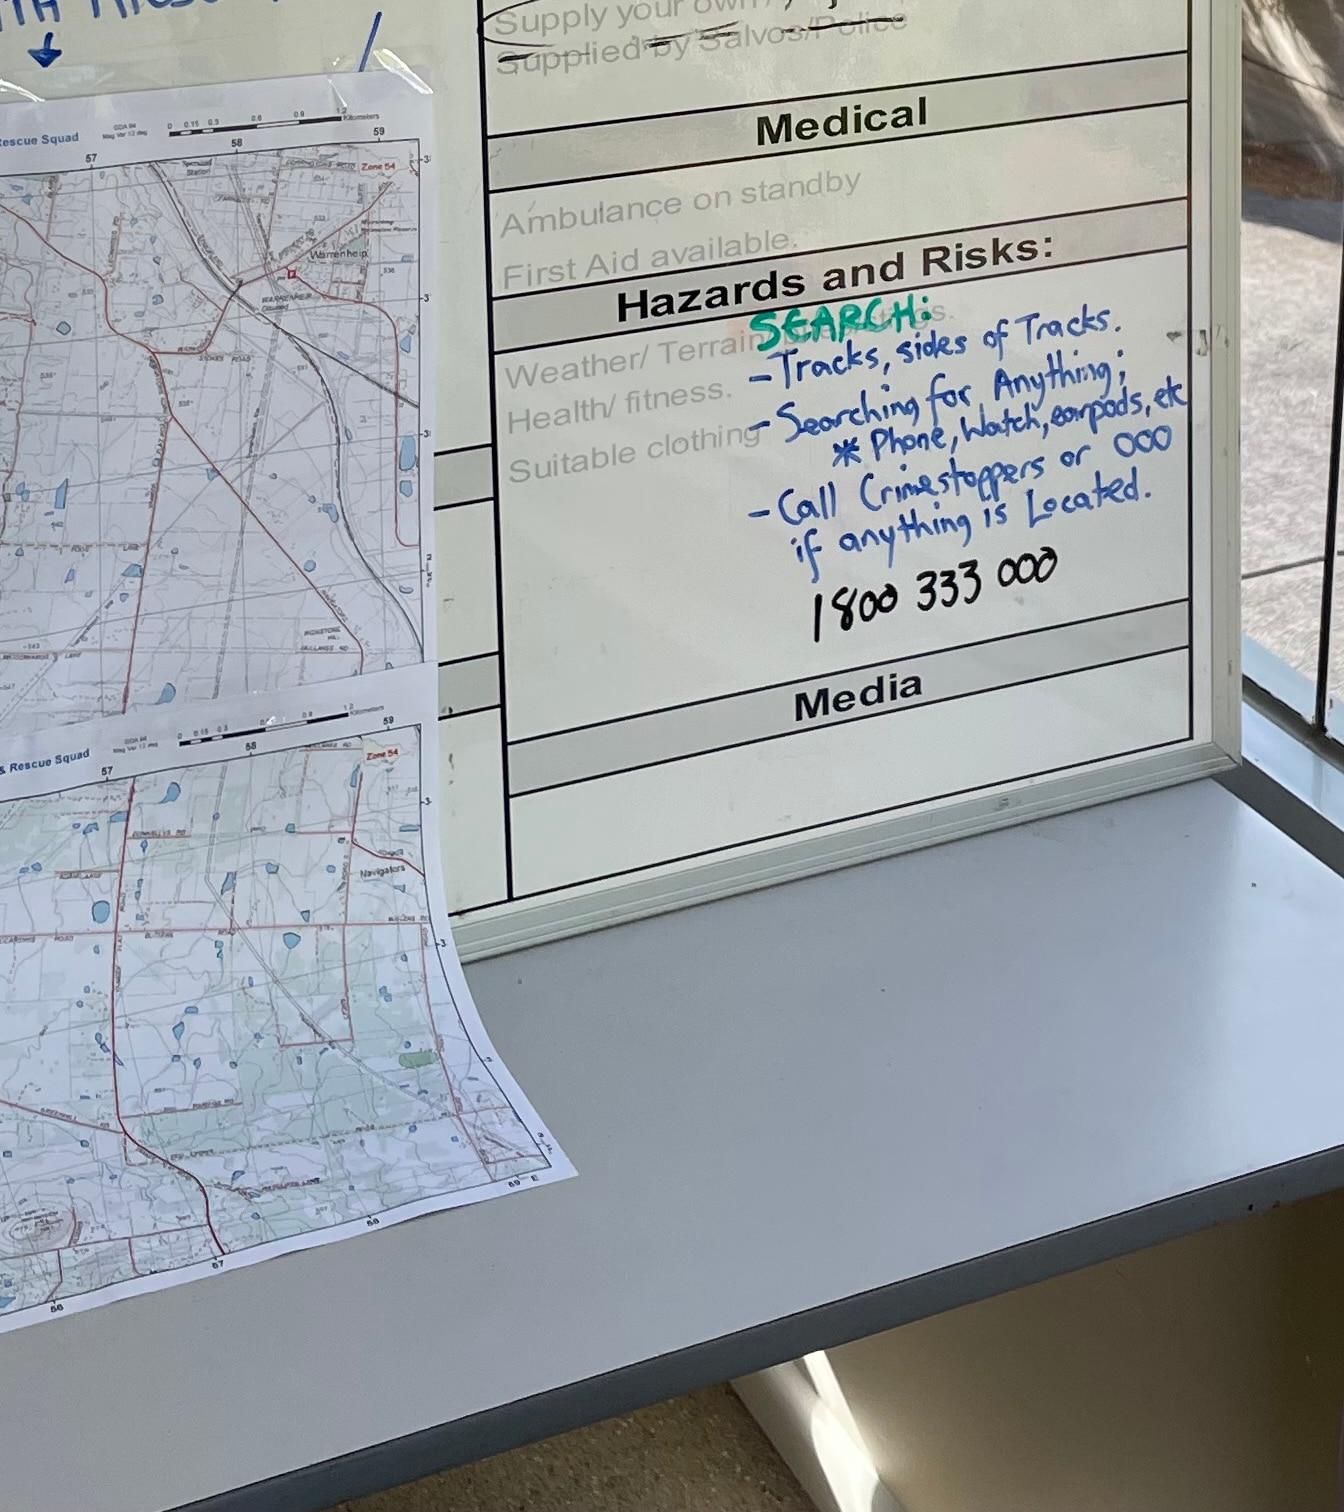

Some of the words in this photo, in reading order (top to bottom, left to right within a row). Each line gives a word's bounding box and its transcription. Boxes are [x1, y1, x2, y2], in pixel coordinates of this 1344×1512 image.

[494, 2, 609, 39] Supply
[616, 0, 686, 31] your
[41, 131, 80, 146] Squad
[756, 96, 928, 146] Medical
[500, 194, 682, 239] Ambulance
[692, 189, 732, 214] on
[741, 169, 861, 205] standby
[504, 259, 577, 289] First
[584, 246, 640, 279] Aid
[649, 229, 799, 270] available.
[617, 269, 806, 323] Hazards
[823, 253, 904, 293] and
[920, 235, 1053, 272] Risks:
[749, 294, 932, 352] SEARCH:
[896, 326, 967, 365] sides
[983, 319, 1009, 352] of
[505, 343, 650, 390] Weather/
[507, 392, 617, 435] Health/
[625, 381, 733, 415] fitness.
[925, 372, 972, 425] for
[509, 441, 637, 483] Suitable
[647, 422, 762, 460] clothing
[1059, 445, 1091, 467] or
[790, 527, 822, 584] if
[838, 500, 973, 568] anything
[984, 505, 1009, 530] is
[811, 583, 898, 643] 1800
[916, 559, 983, 612] 333
[997, 545, 1058, 587] 000
[793, 671, 924, 723] Media
[9, 757, 52, 773] Rescue
[54, 748, 91, 766] Squad
